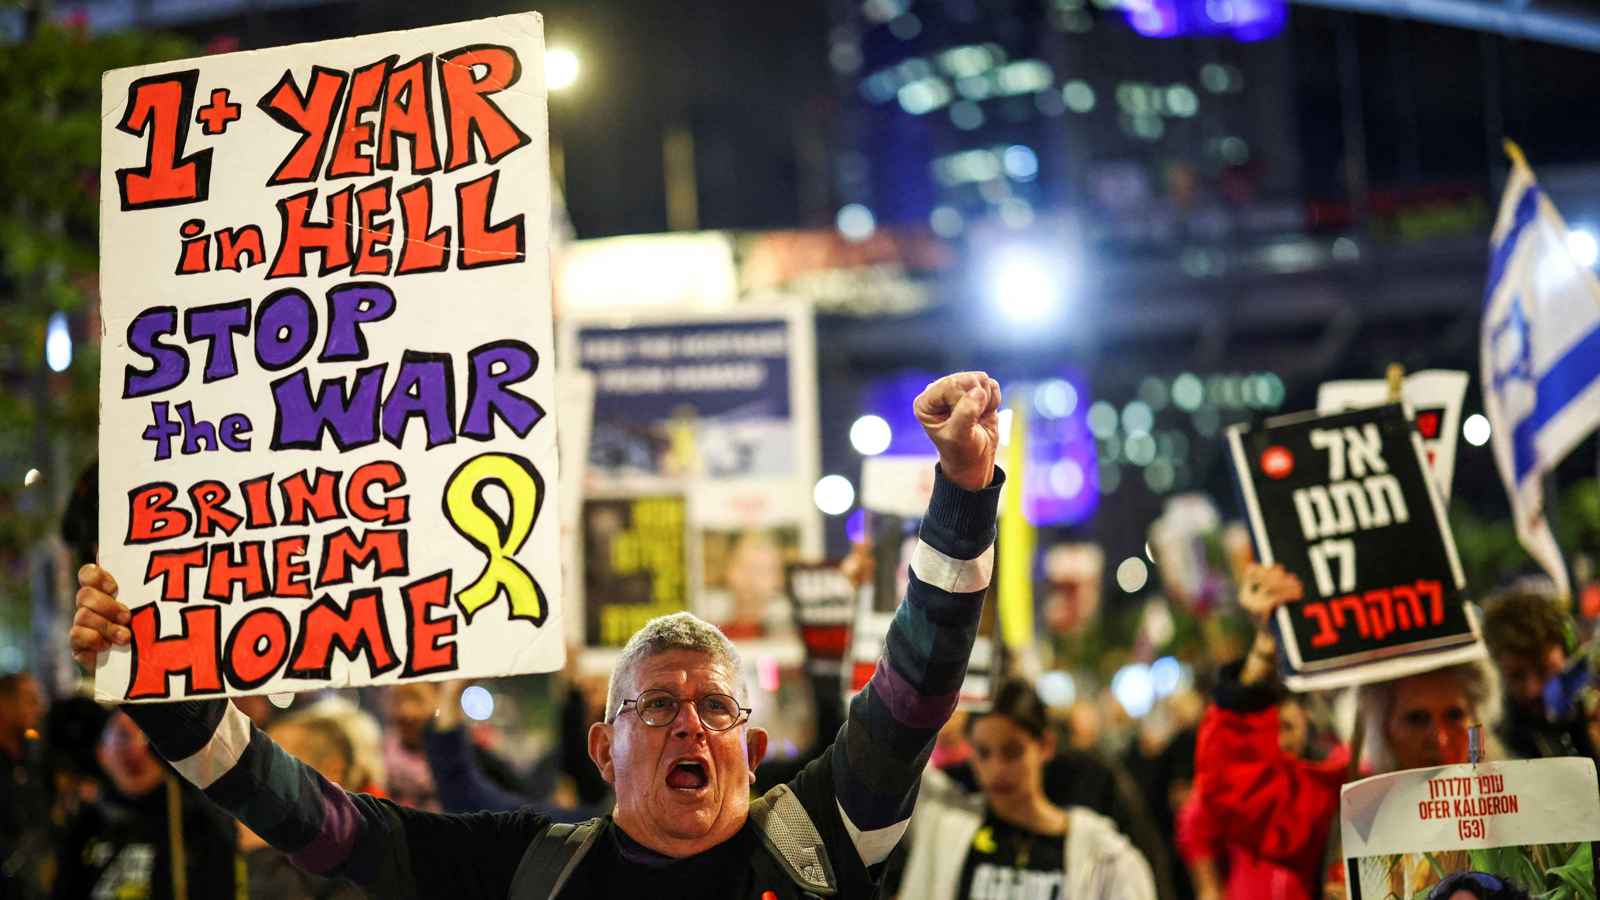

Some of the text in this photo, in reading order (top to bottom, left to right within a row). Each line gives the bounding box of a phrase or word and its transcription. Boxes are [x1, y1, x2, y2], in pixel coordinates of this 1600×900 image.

[115, 44, 532, 211] 1+ YEAR
[175, 169, 526, 280] in HELL
[122, 281, 396, 399] STOP
[142, 339, 547, 461] the WAR
[1309, 421, 1389, 480] אל
[124, 461, 410, 545] BRING
[1293, 473, 1409, 540] תתנו
[144, 528, 408, 603] THEM
[1308, 538, 1356, 597] לו
[125, 569, 459, 700] HOME
[1303, 578, 1445, 648] להקריב
[1418, 795, 1519, 819] OFER KALDERON
[1428, 774, 1504, 800] עופר קלדרון
[1458, 818, 1486, 841] (53)
